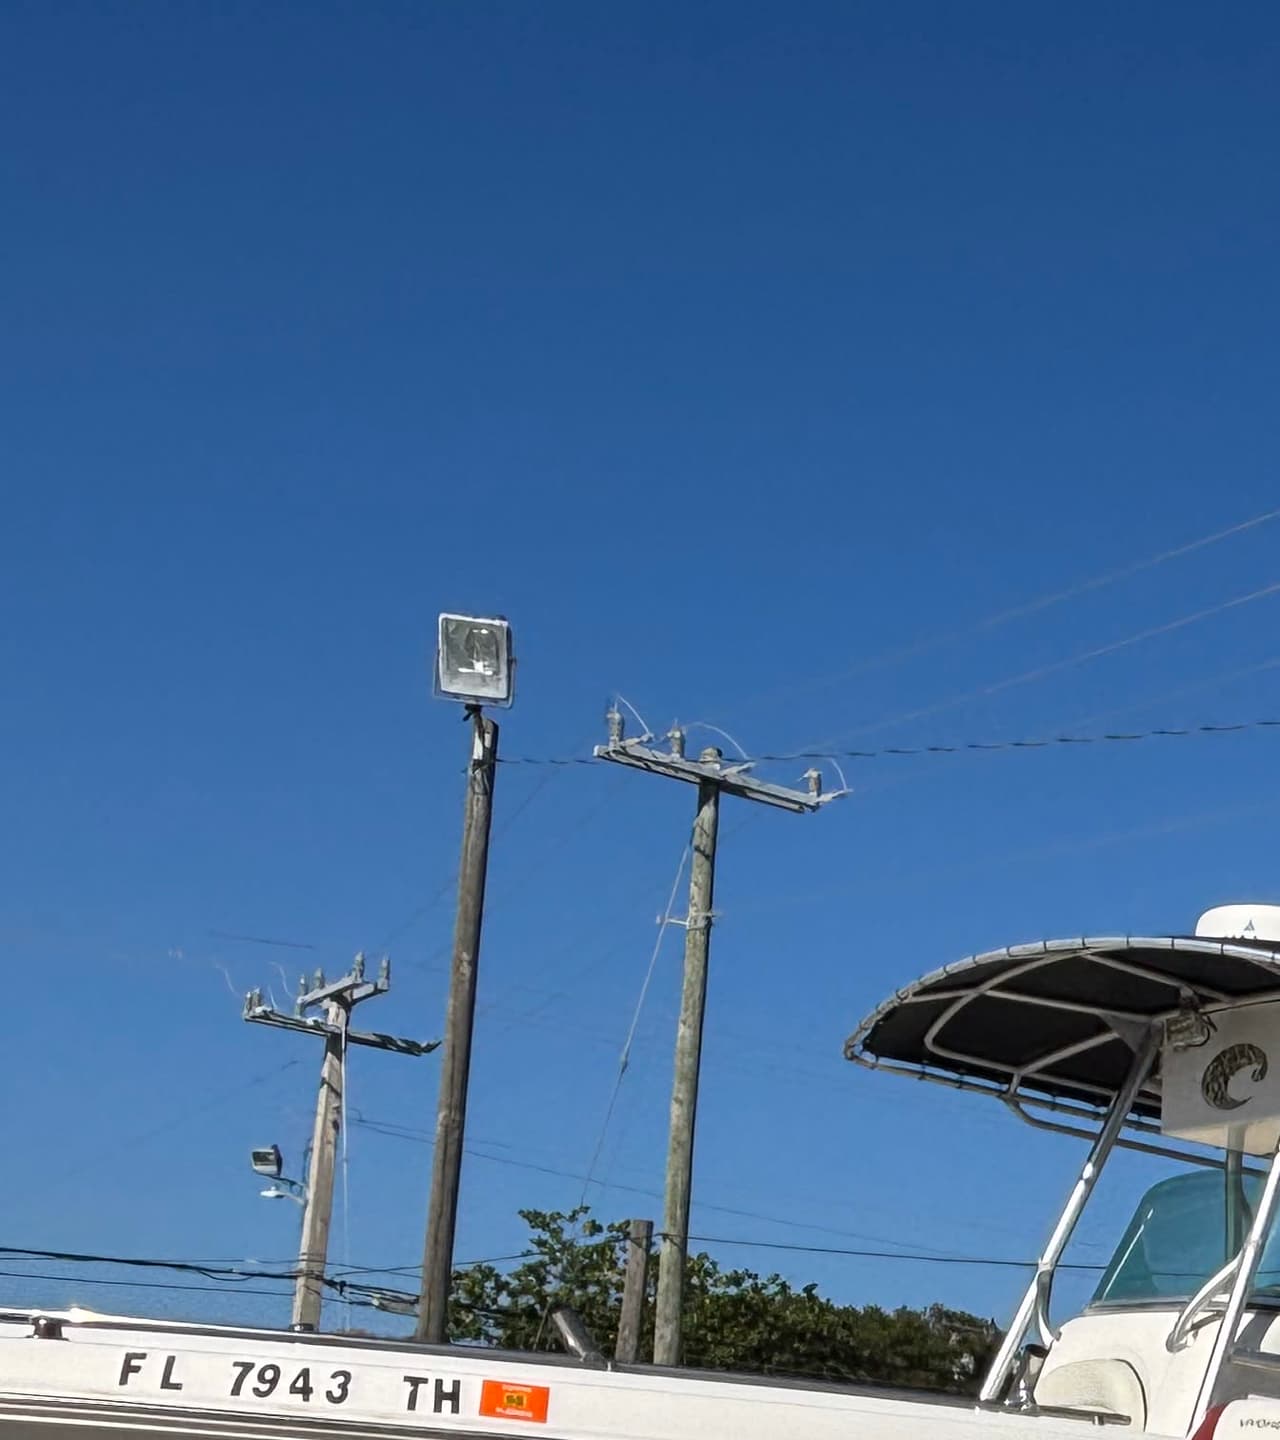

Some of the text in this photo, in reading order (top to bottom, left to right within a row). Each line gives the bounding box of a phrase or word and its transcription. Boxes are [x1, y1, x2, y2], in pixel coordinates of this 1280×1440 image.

[118, 1352, 461, 1414] FL 7943 TH
